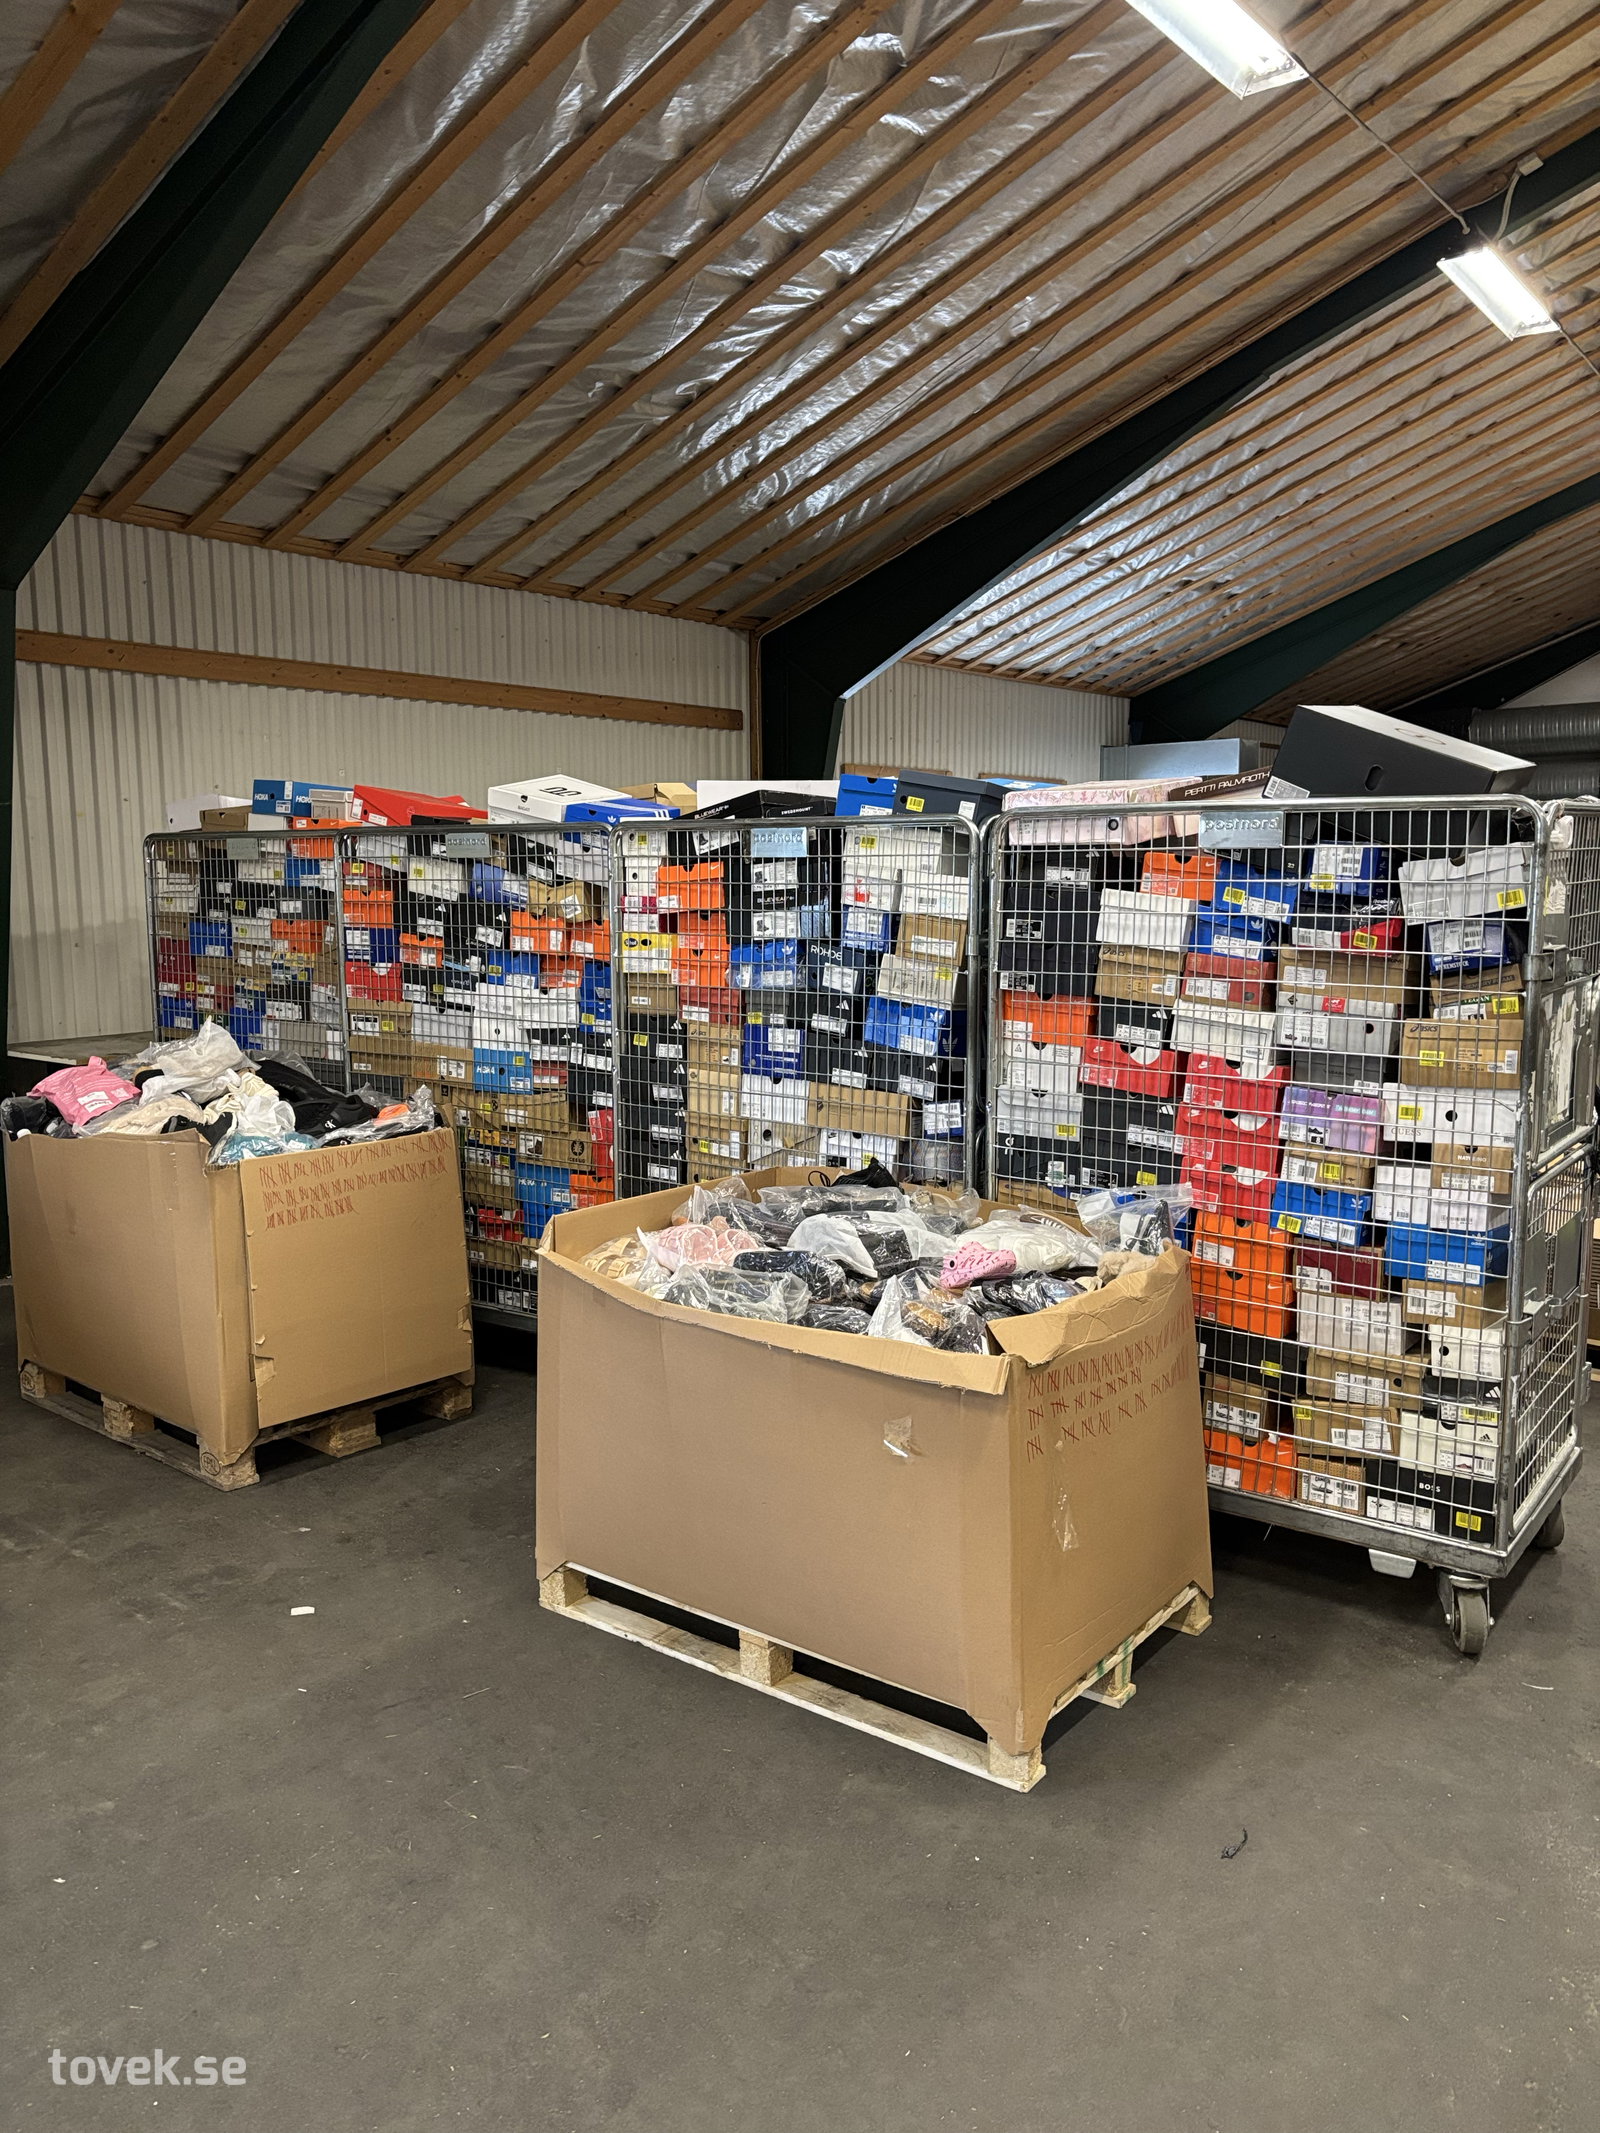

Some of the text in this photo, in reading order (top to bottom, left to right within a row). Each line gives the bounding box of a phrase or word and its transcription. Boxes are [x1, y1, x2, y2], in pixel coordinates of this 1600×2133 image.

[1183, 772, 1270, 797] PERTTI PALMROTH
[1204, 816, 1280, 832] postnord
